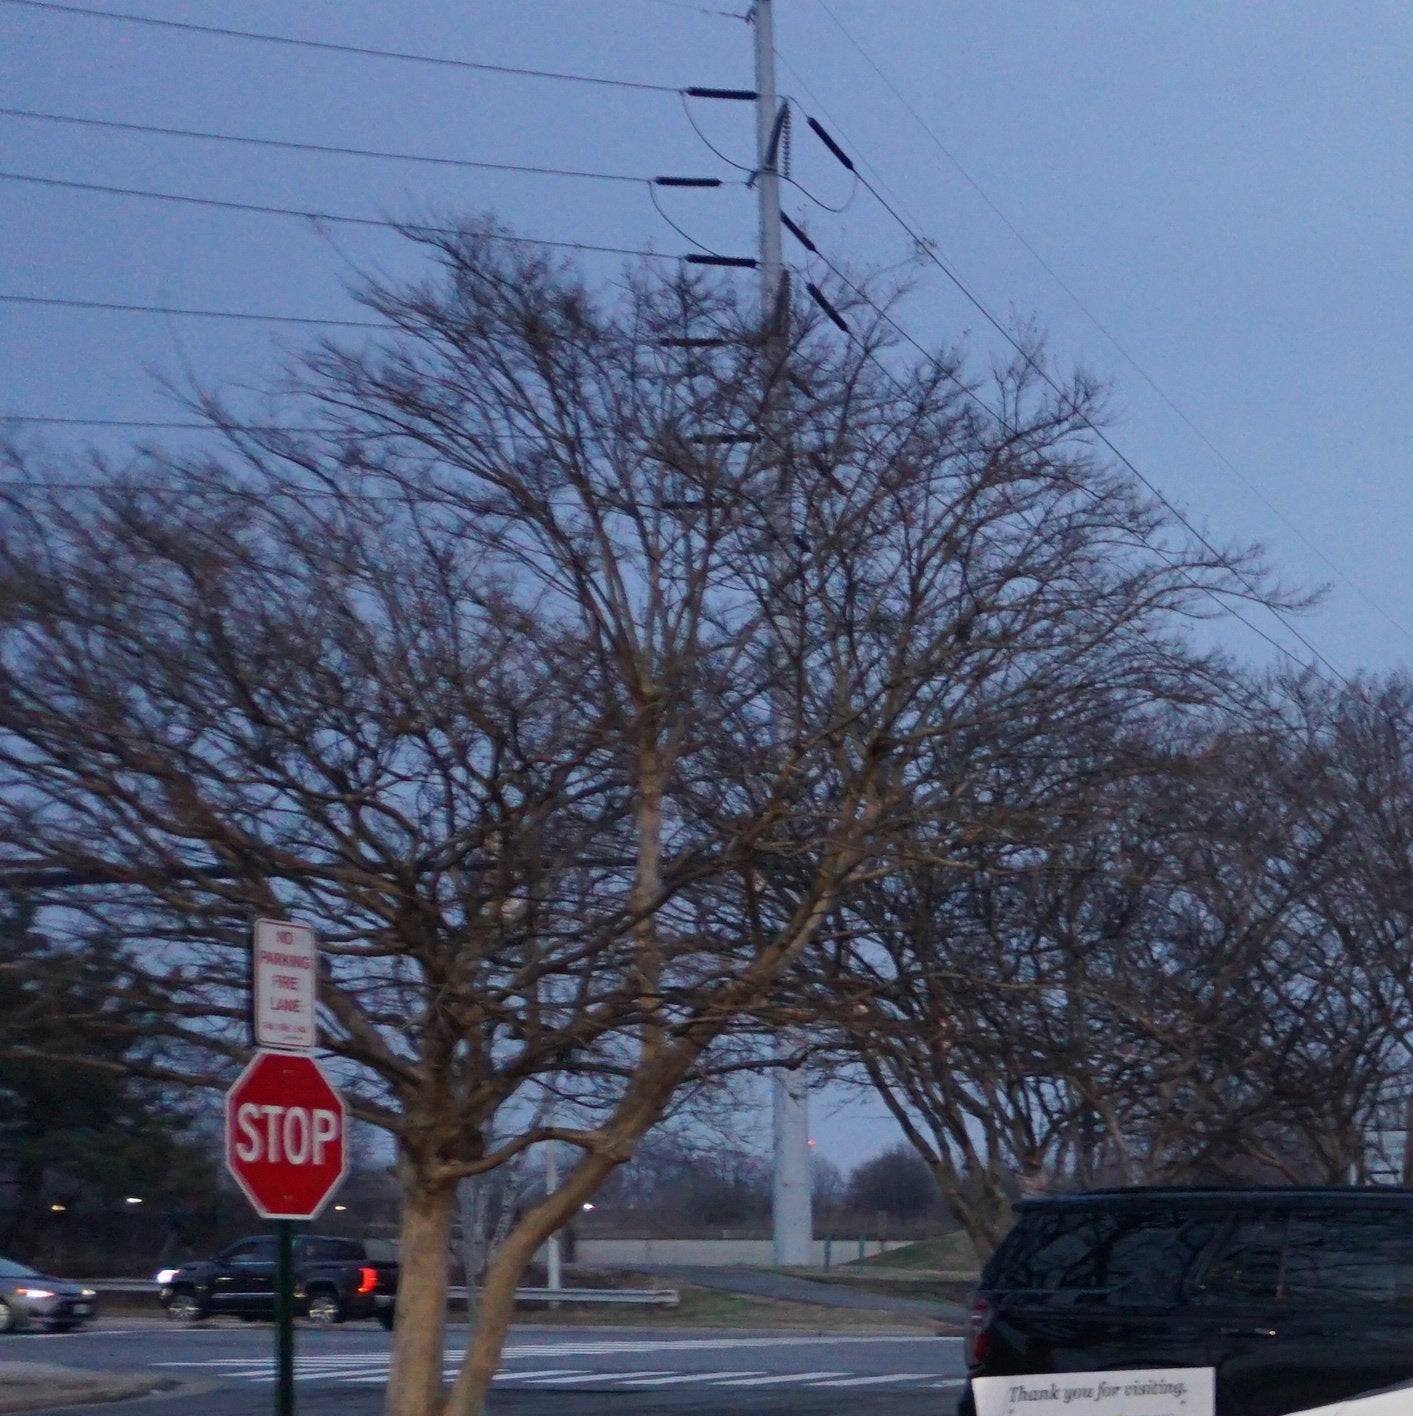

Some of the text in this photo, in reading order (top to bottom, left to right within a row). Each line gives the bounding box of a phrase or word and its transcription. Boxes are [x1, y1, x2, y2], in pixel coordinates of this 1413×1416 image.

[276, 931, 294, 945] NO
[260, 950, 310, 970] PARKING
[271, 974, 298, 991] FIRE
[270, 997, 302, 1013] LANE
[235, 1103, 337, 1166] STOP
[1009, 1384, 1060, 1402] Thank
[1063, 1386, 1094, 1403] you
[1095, 1381, 1121, 1401] for
